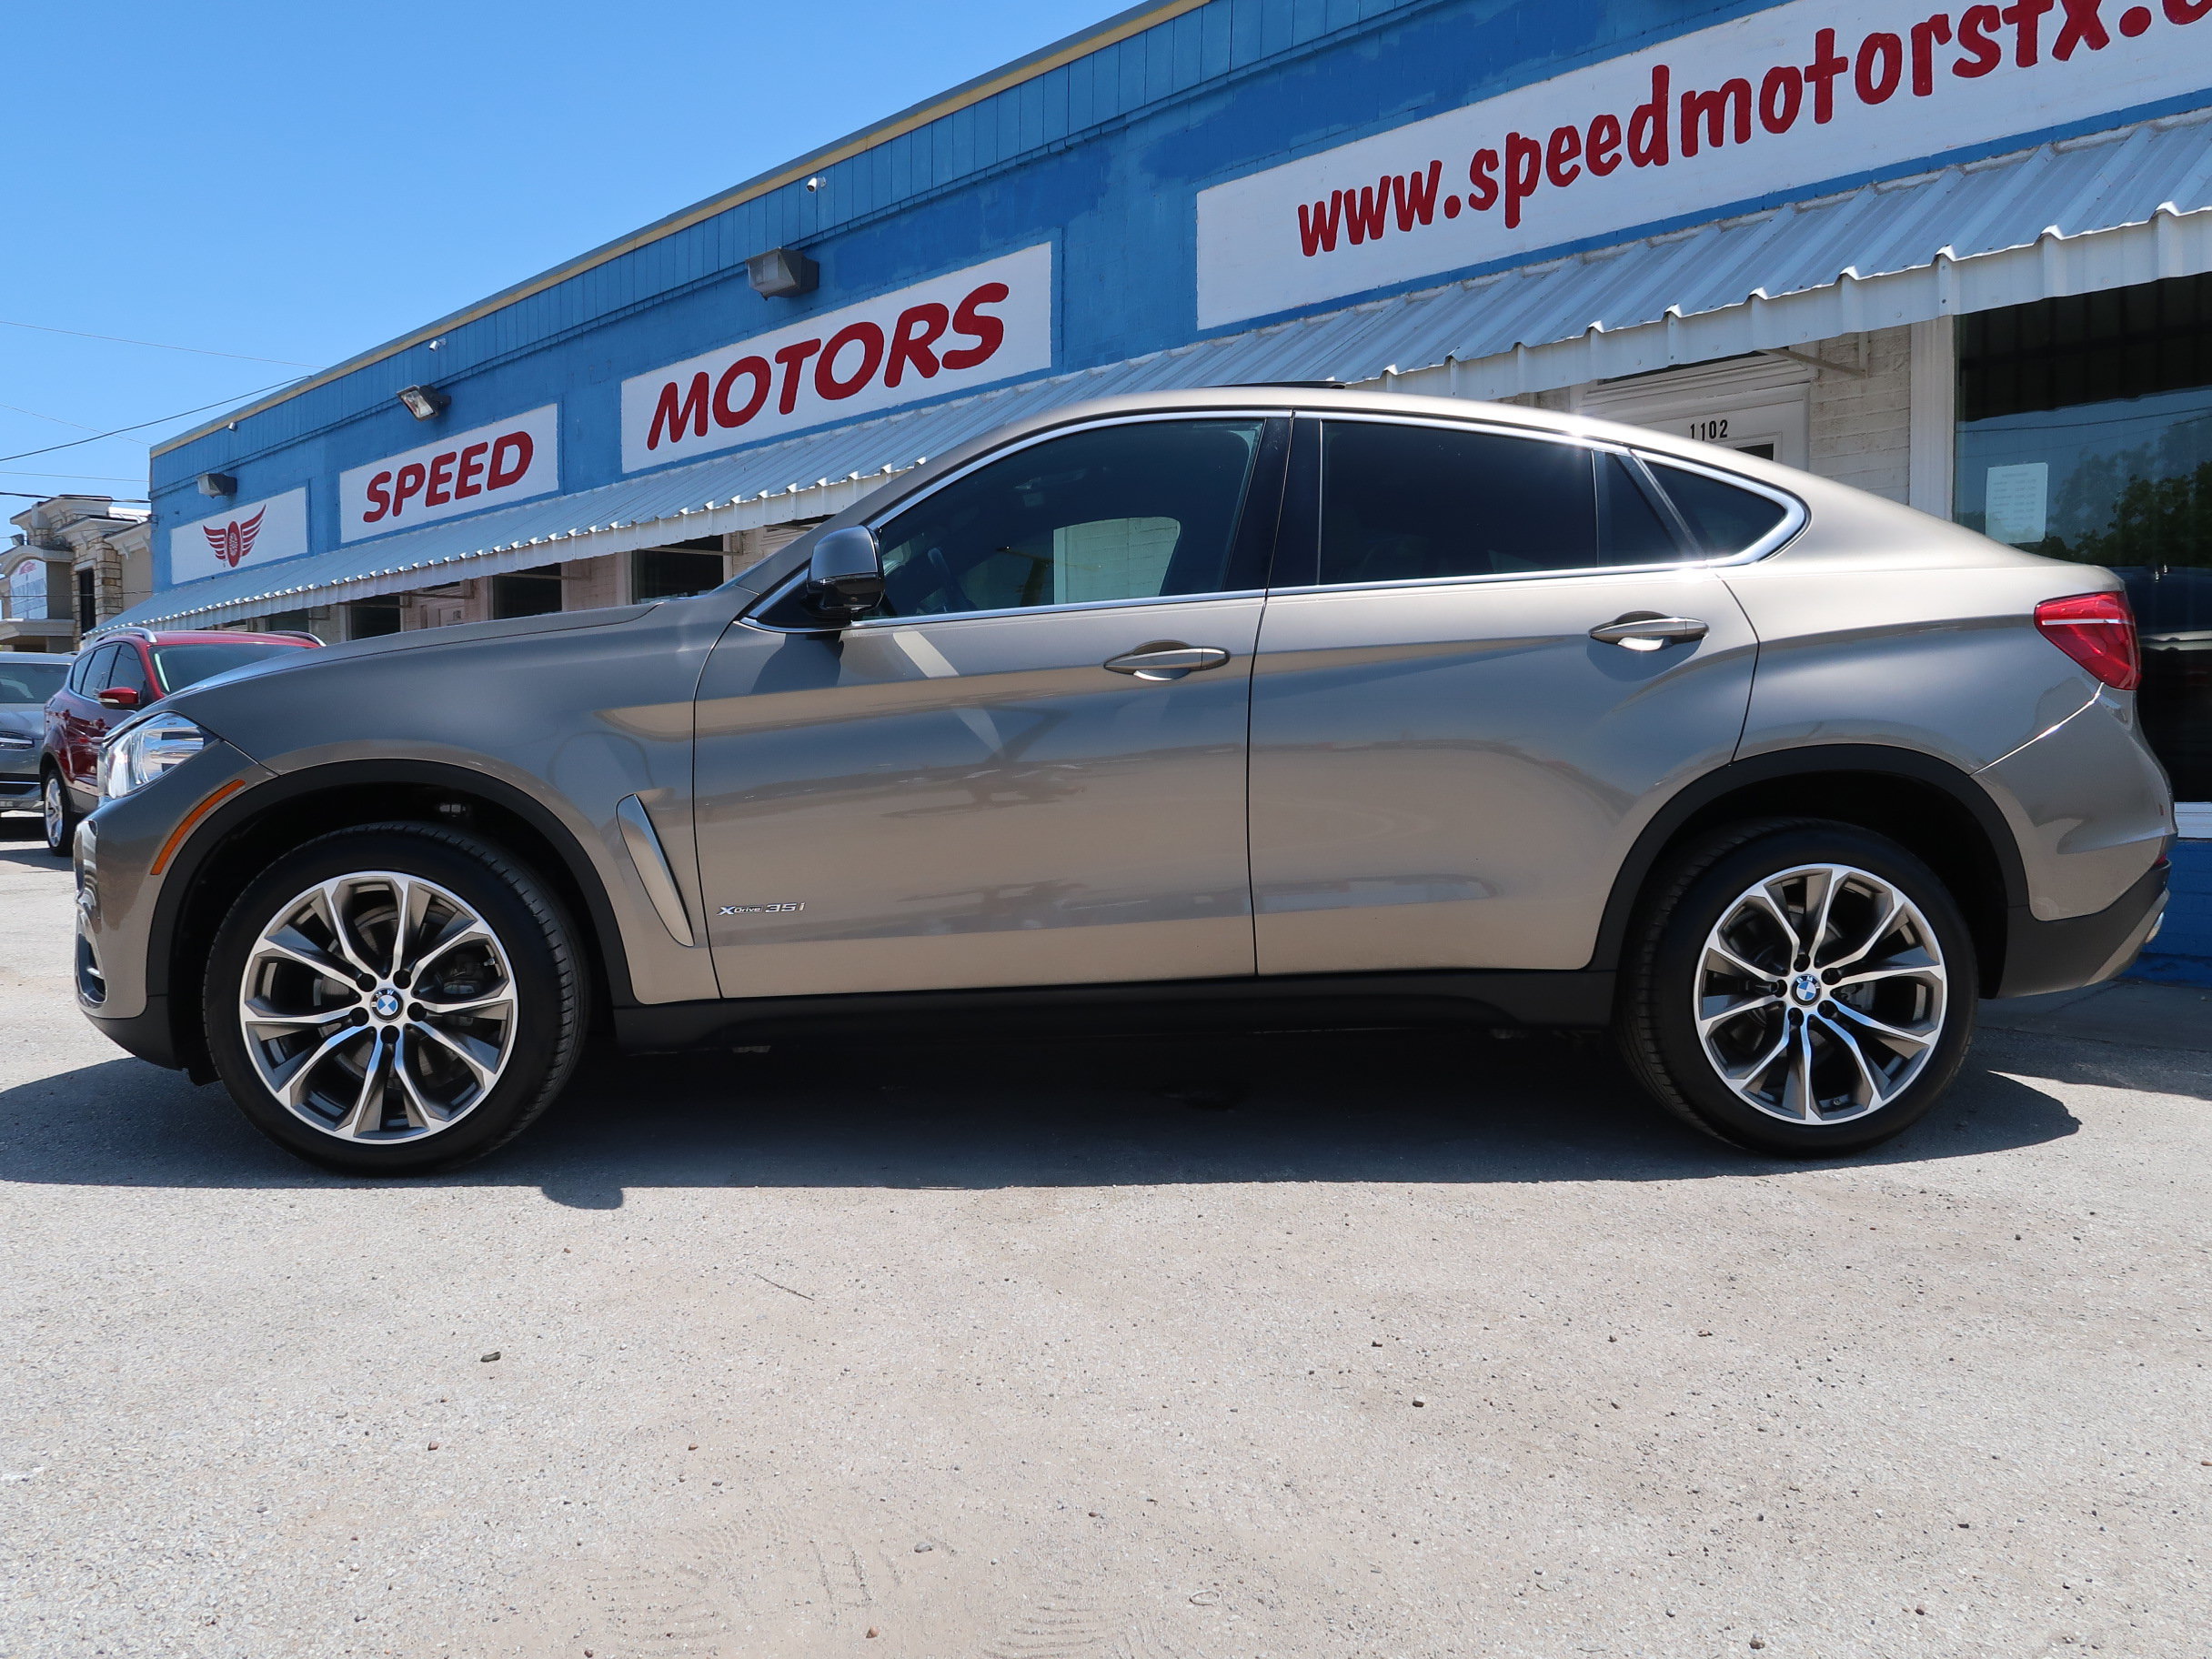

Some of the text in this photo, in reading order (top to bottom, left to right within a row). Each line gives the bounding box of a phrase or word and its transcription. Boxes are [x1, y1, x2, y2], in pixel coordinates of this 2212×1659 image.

[649, 282, 1009, 451] MOTORS
[362, 430, 535, 524] SPEED
[1690, 419, 1728, 441] 1102
